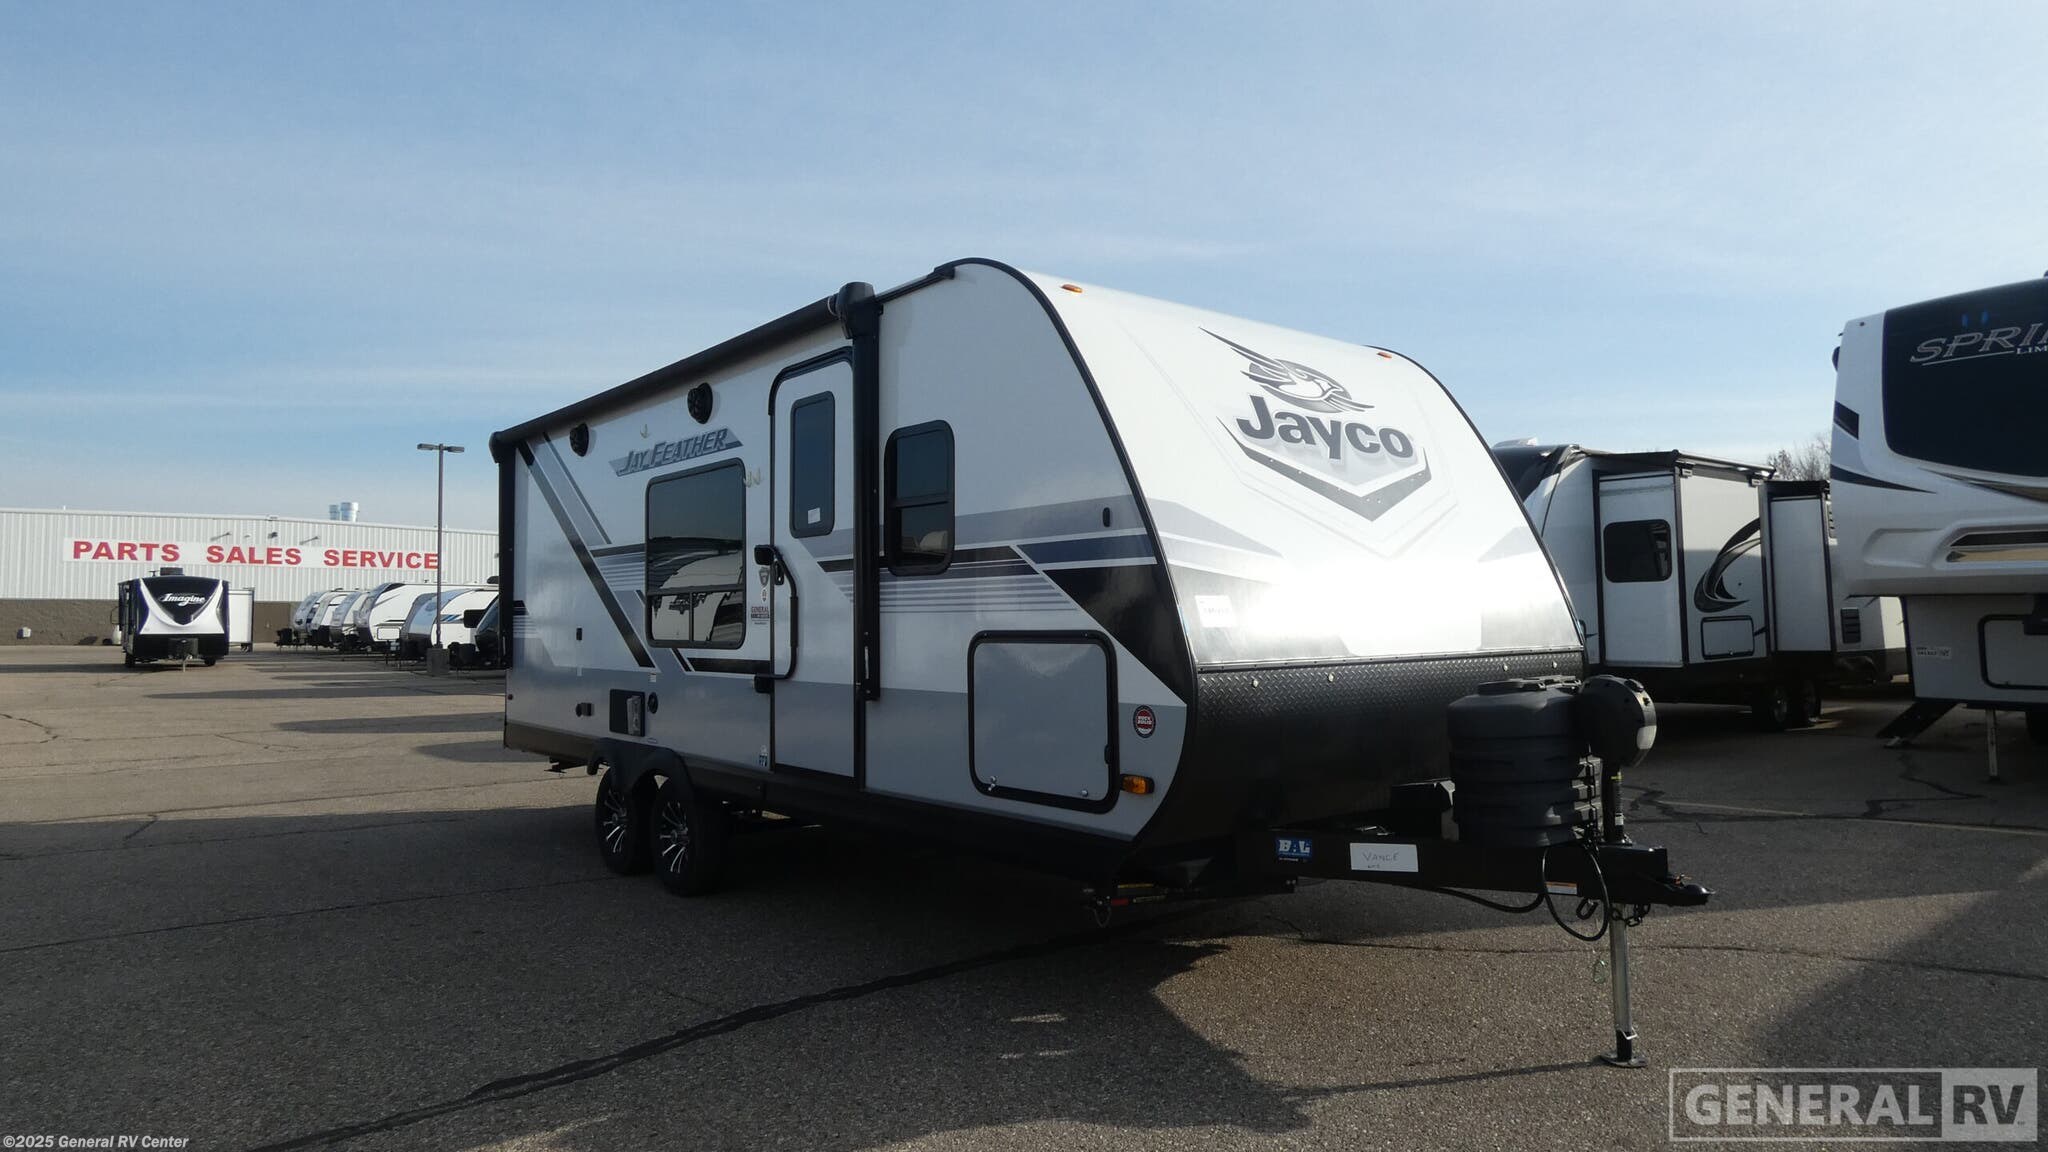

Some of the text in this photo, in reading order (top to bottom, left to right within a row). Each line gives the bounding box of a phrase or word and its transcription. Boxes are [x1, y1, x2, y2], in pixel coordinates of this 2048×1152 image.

[1236, 395, 1414, 460] Jayco
[650, 428, 728, 467] FEATHER
[72, 541, 439, 569] PARTS SALES SERVICE
[162, 592, 205, 607] Imagine
